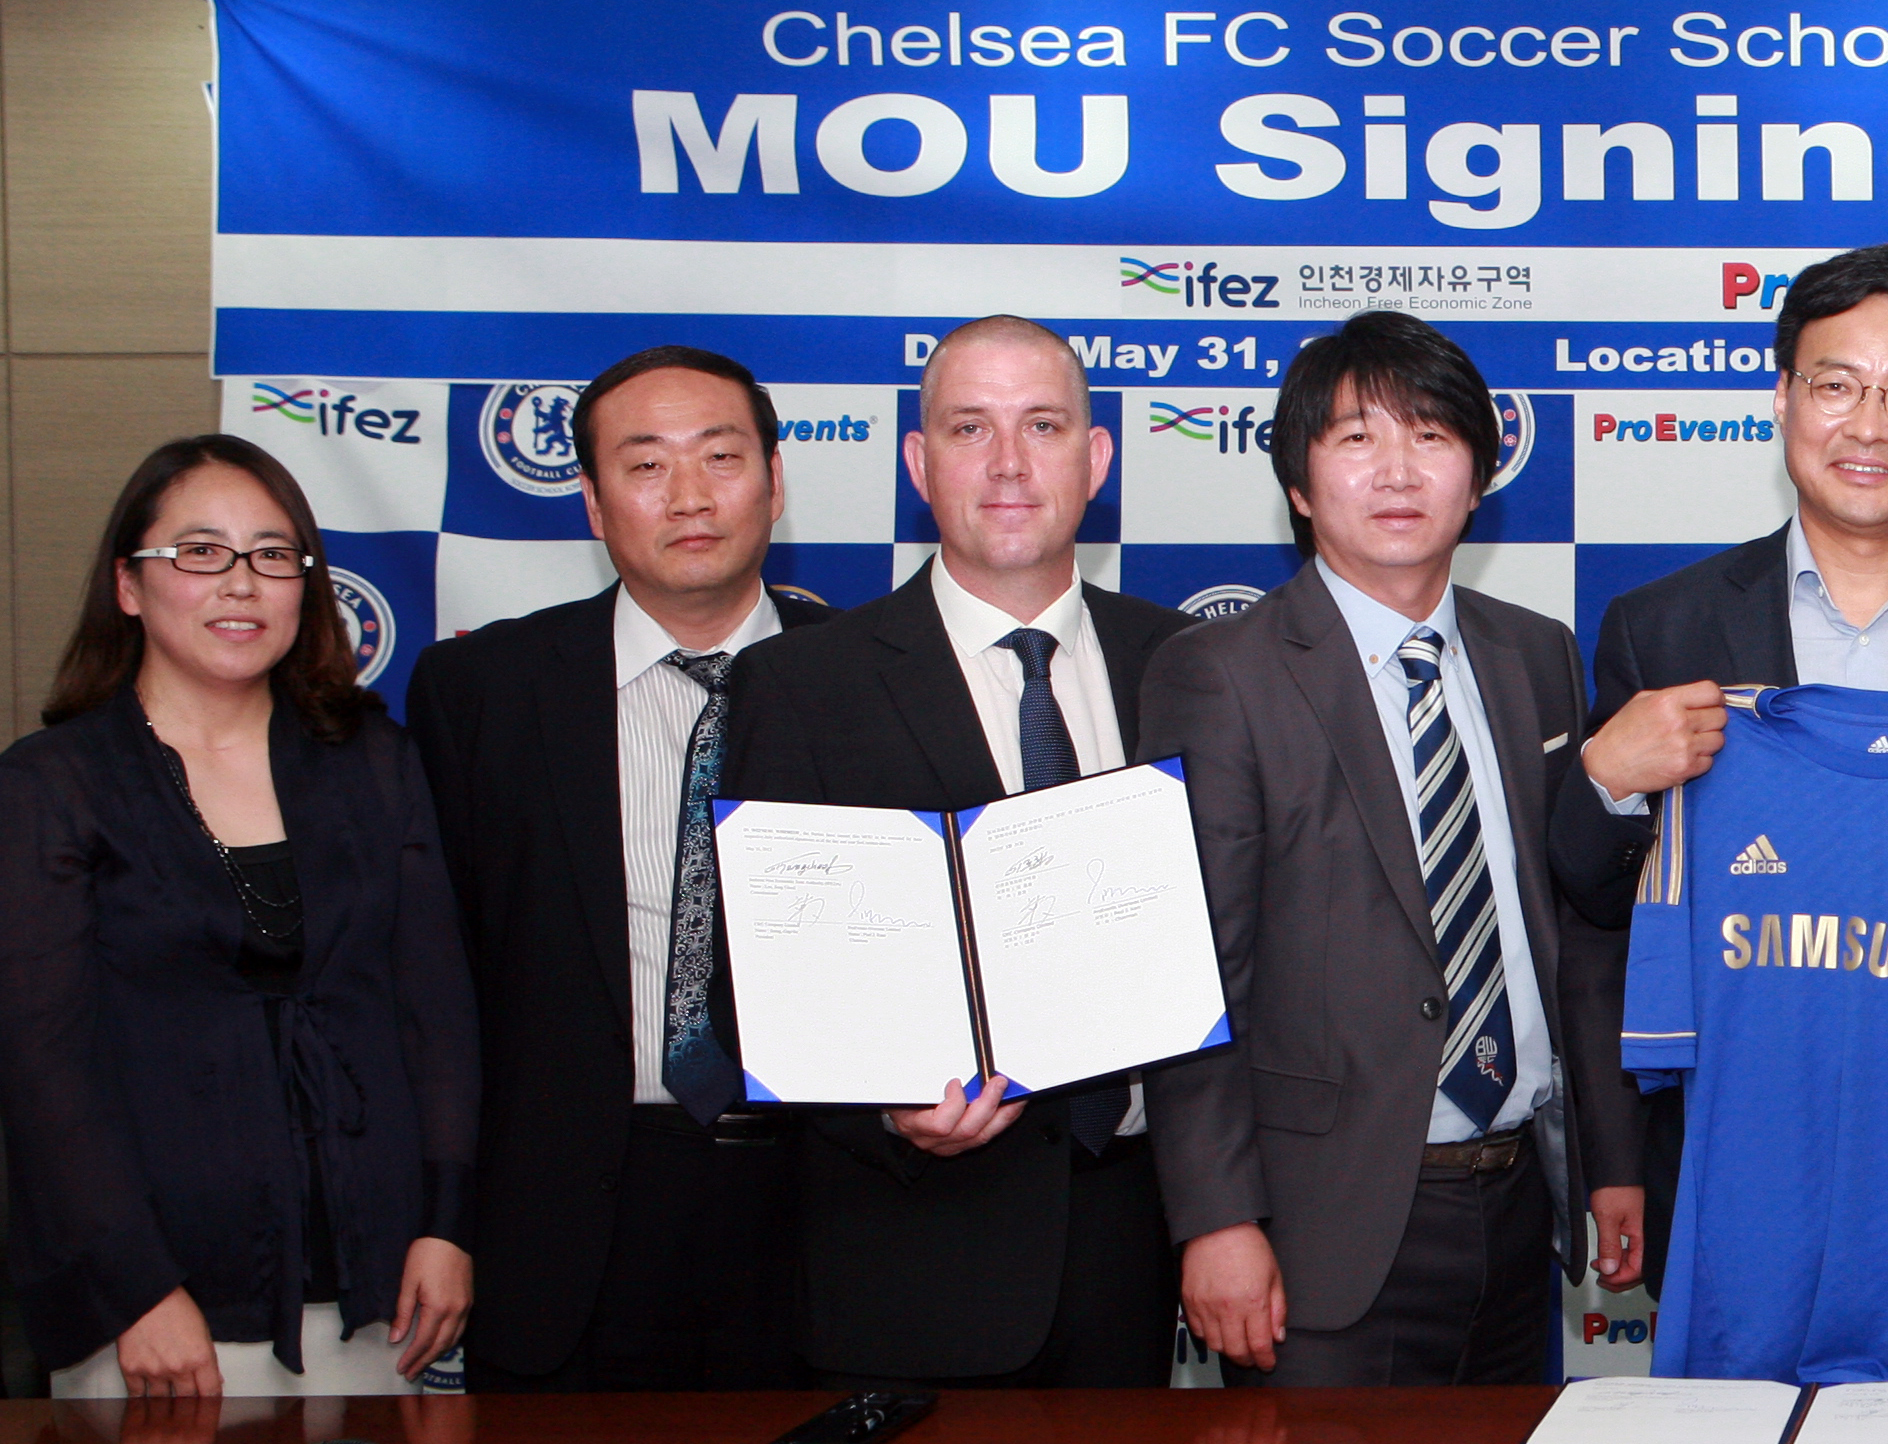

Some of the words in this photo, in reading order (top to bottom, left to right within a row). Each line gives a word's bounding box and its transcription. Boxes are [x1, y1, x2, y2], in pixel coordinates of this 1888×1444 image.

[762, 10, 1127, 68] Chelsea
[1164, 11, 1291, 68] FC
[1325, 11, 1640, 68] Soccer
[631, 89, 1130, 199] MOU
[1183, 260, 1281, 309] ifez
[1298, 264, 1531, 293] 인천경제자유구역
[1298, 296, 1362, 310] Incheon
[1367, 296, 1403, 310] Free
[1409, 296, 1487, 310] Economic
[1491, 296, 1533, 310] Zone
[1068, 335, 1180, 378] May
[1196, 335, 1279, 378] 31,
[318, 389, 421, 445] ifez
[1218, 405, 1274, 455] ife
[1593, 413, 1775, 443] ProEvents
[1730, 859, 1788, 875] adidas
